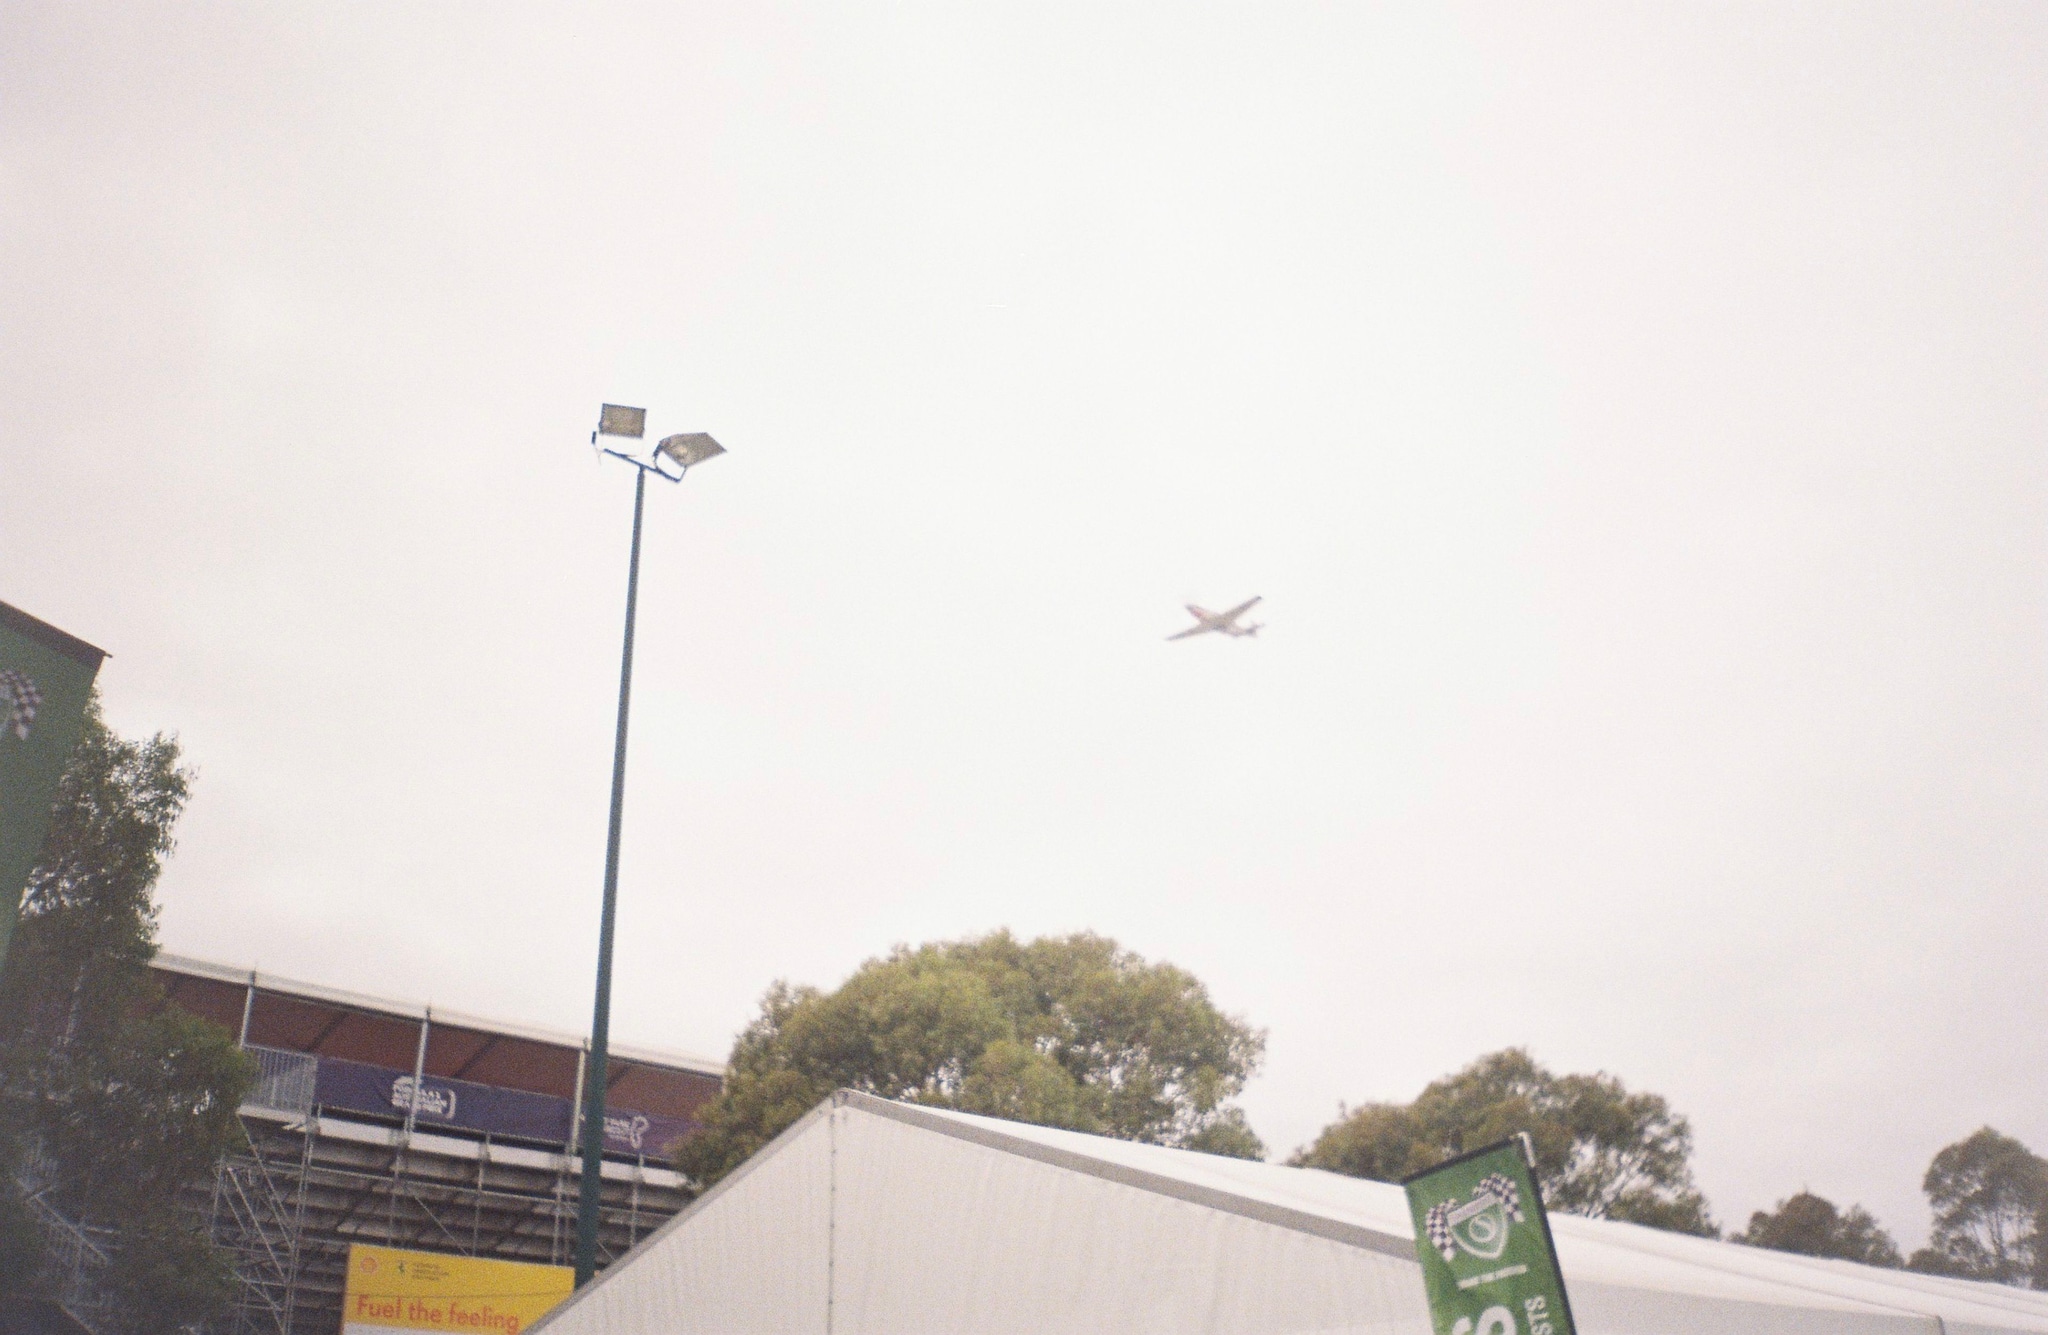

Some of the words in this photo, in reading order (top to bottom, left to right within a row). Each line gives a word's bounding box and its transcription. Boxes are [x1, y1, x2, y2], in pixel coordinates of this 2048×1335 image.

[356, 1294, 402, 1319] Fuel
[408, 1299, 443, 1323] the
[449, 1301, 520, 1335] feeling
